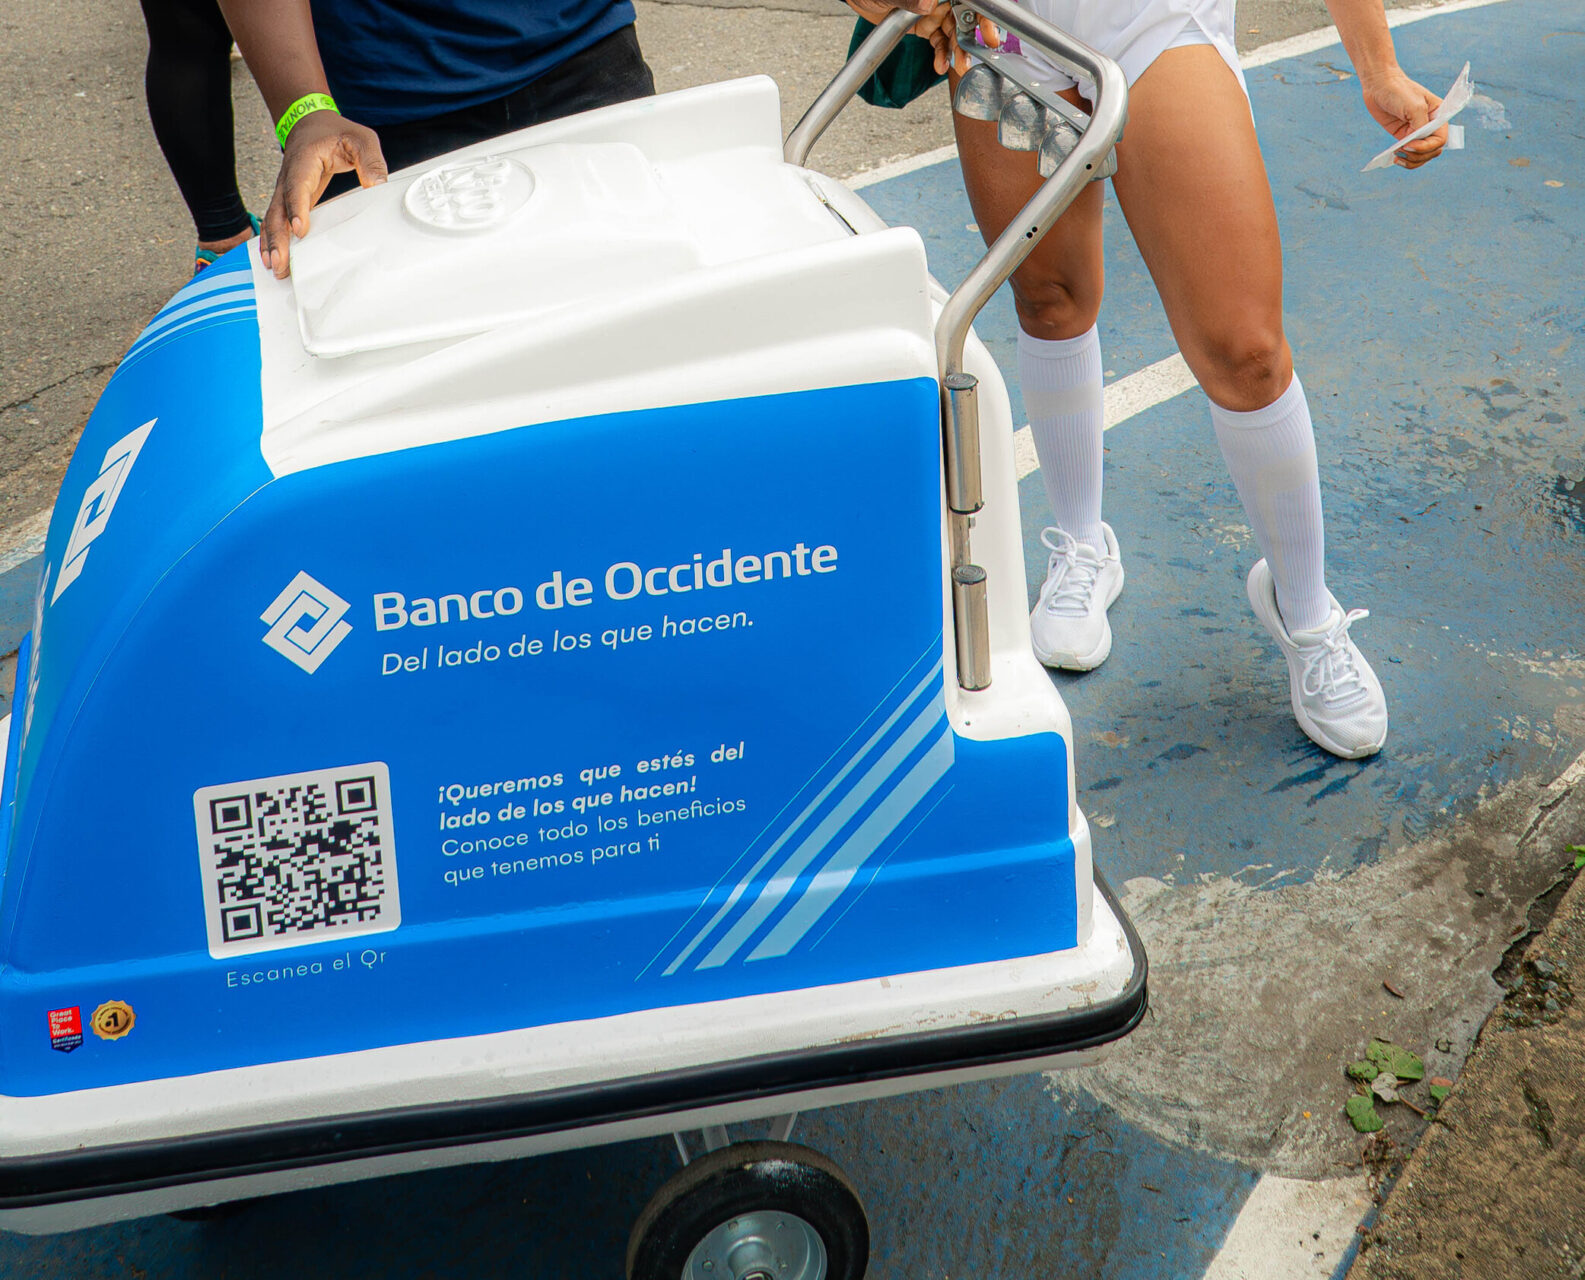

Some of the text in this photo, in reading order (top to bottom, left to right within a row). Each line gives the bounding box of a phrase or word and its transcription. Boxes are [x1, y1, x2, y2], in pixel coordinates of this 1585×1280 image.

[373, 542, 838, 632] Banco de Occidente
[382, 611, 754, 675] Del lado de los que hacen.
[438, 740, 745, 805] ¡Queremos que estés del
[440, 775, 697, 830] lado de los que hacen!
[441, 797, 746, 856] Conoce todo los beneficios
[444, 832, 660, 886] que tenemos para ti
[227, 949, 387, 988] Escanea el Qr
[50, 1009, 72, 1018] Great
[51, 1016, 73, 1024] Place
